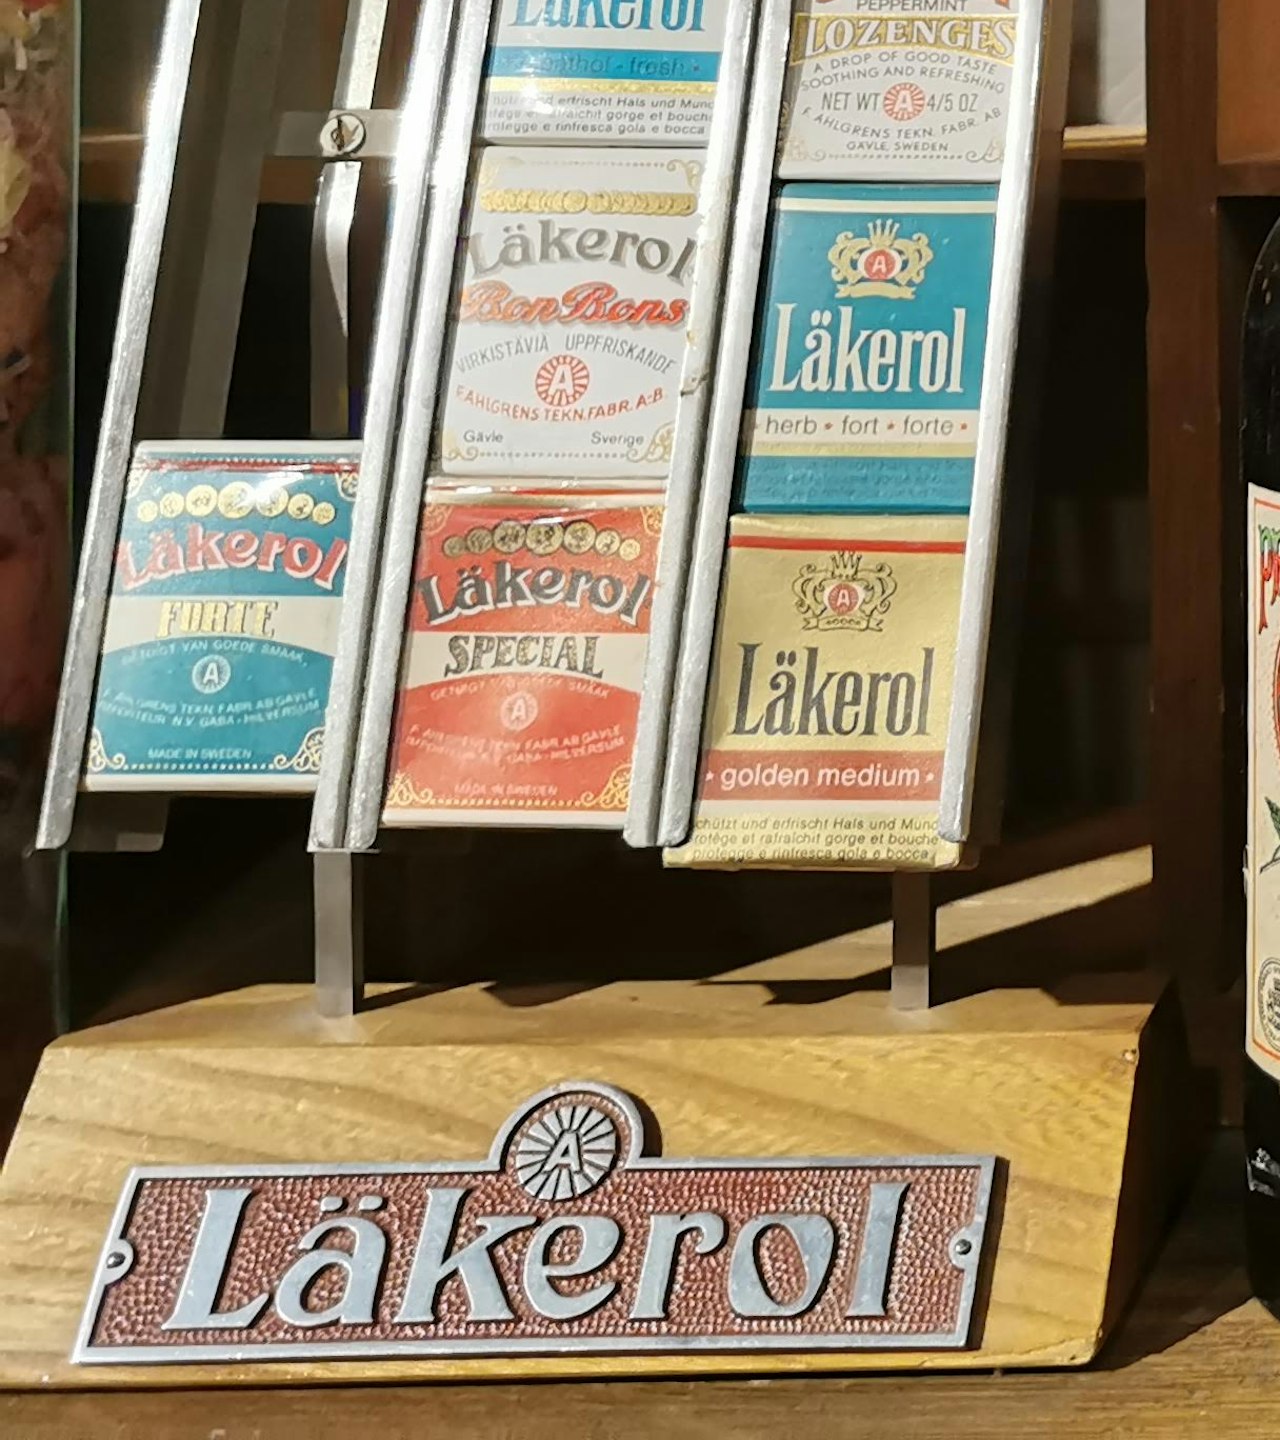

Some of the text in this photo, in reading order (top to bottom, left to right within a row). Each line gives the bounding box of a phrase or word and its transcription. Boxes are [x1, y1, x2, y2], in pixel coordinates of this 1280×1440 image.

[805, 18, 1017, 58] LOZENGES
[813, 51, 998, 76] A DROP OF GOOD TASTE
[801, 66, 1005, 94] SOOTHING AND REFRESHING
[651, 98, 676, 109] und
[822, 92, 881, 111] NET WT
[927, 93, 979, 112] 4/5 OZ
[814, 114, 890, 139] AHLGRENS
[984, 107, 1001, 122] AB
[894, 141, 949, 152] SWEDEN
[468, 219, 698, 286] Läkerol
[871, 255, 886, 273] A
[565, 333, 676, 375] UPPFRISKANDE
[767, 303, 966, 393] Läkerol
[463, 428, 644, 446] Gävle Sverige
[765, 414, 954, 435] herb fort forte
[115, 523, 349, 591] Läkerol
[418, 561, 651, 627] Läkerol
[156, 600, 278, 640] FORTE
[444, 635, 604, 679] SPECIAL
[202, 662, 220, 684] A
[728, 643, 935, 737] Läkerol
[200, 747, 253, 760] SWEDEN
[721, 764, 920, 791] golden medium
[833, 816, 864, 831] Hals
[869, 817, 896, 831] und
[825, 834, 866, 847] gorge
[871, 833, 885, 845] et
[888, 832, 938, 846] bouche
[161, 1181, 909, 1332] Läkerol
